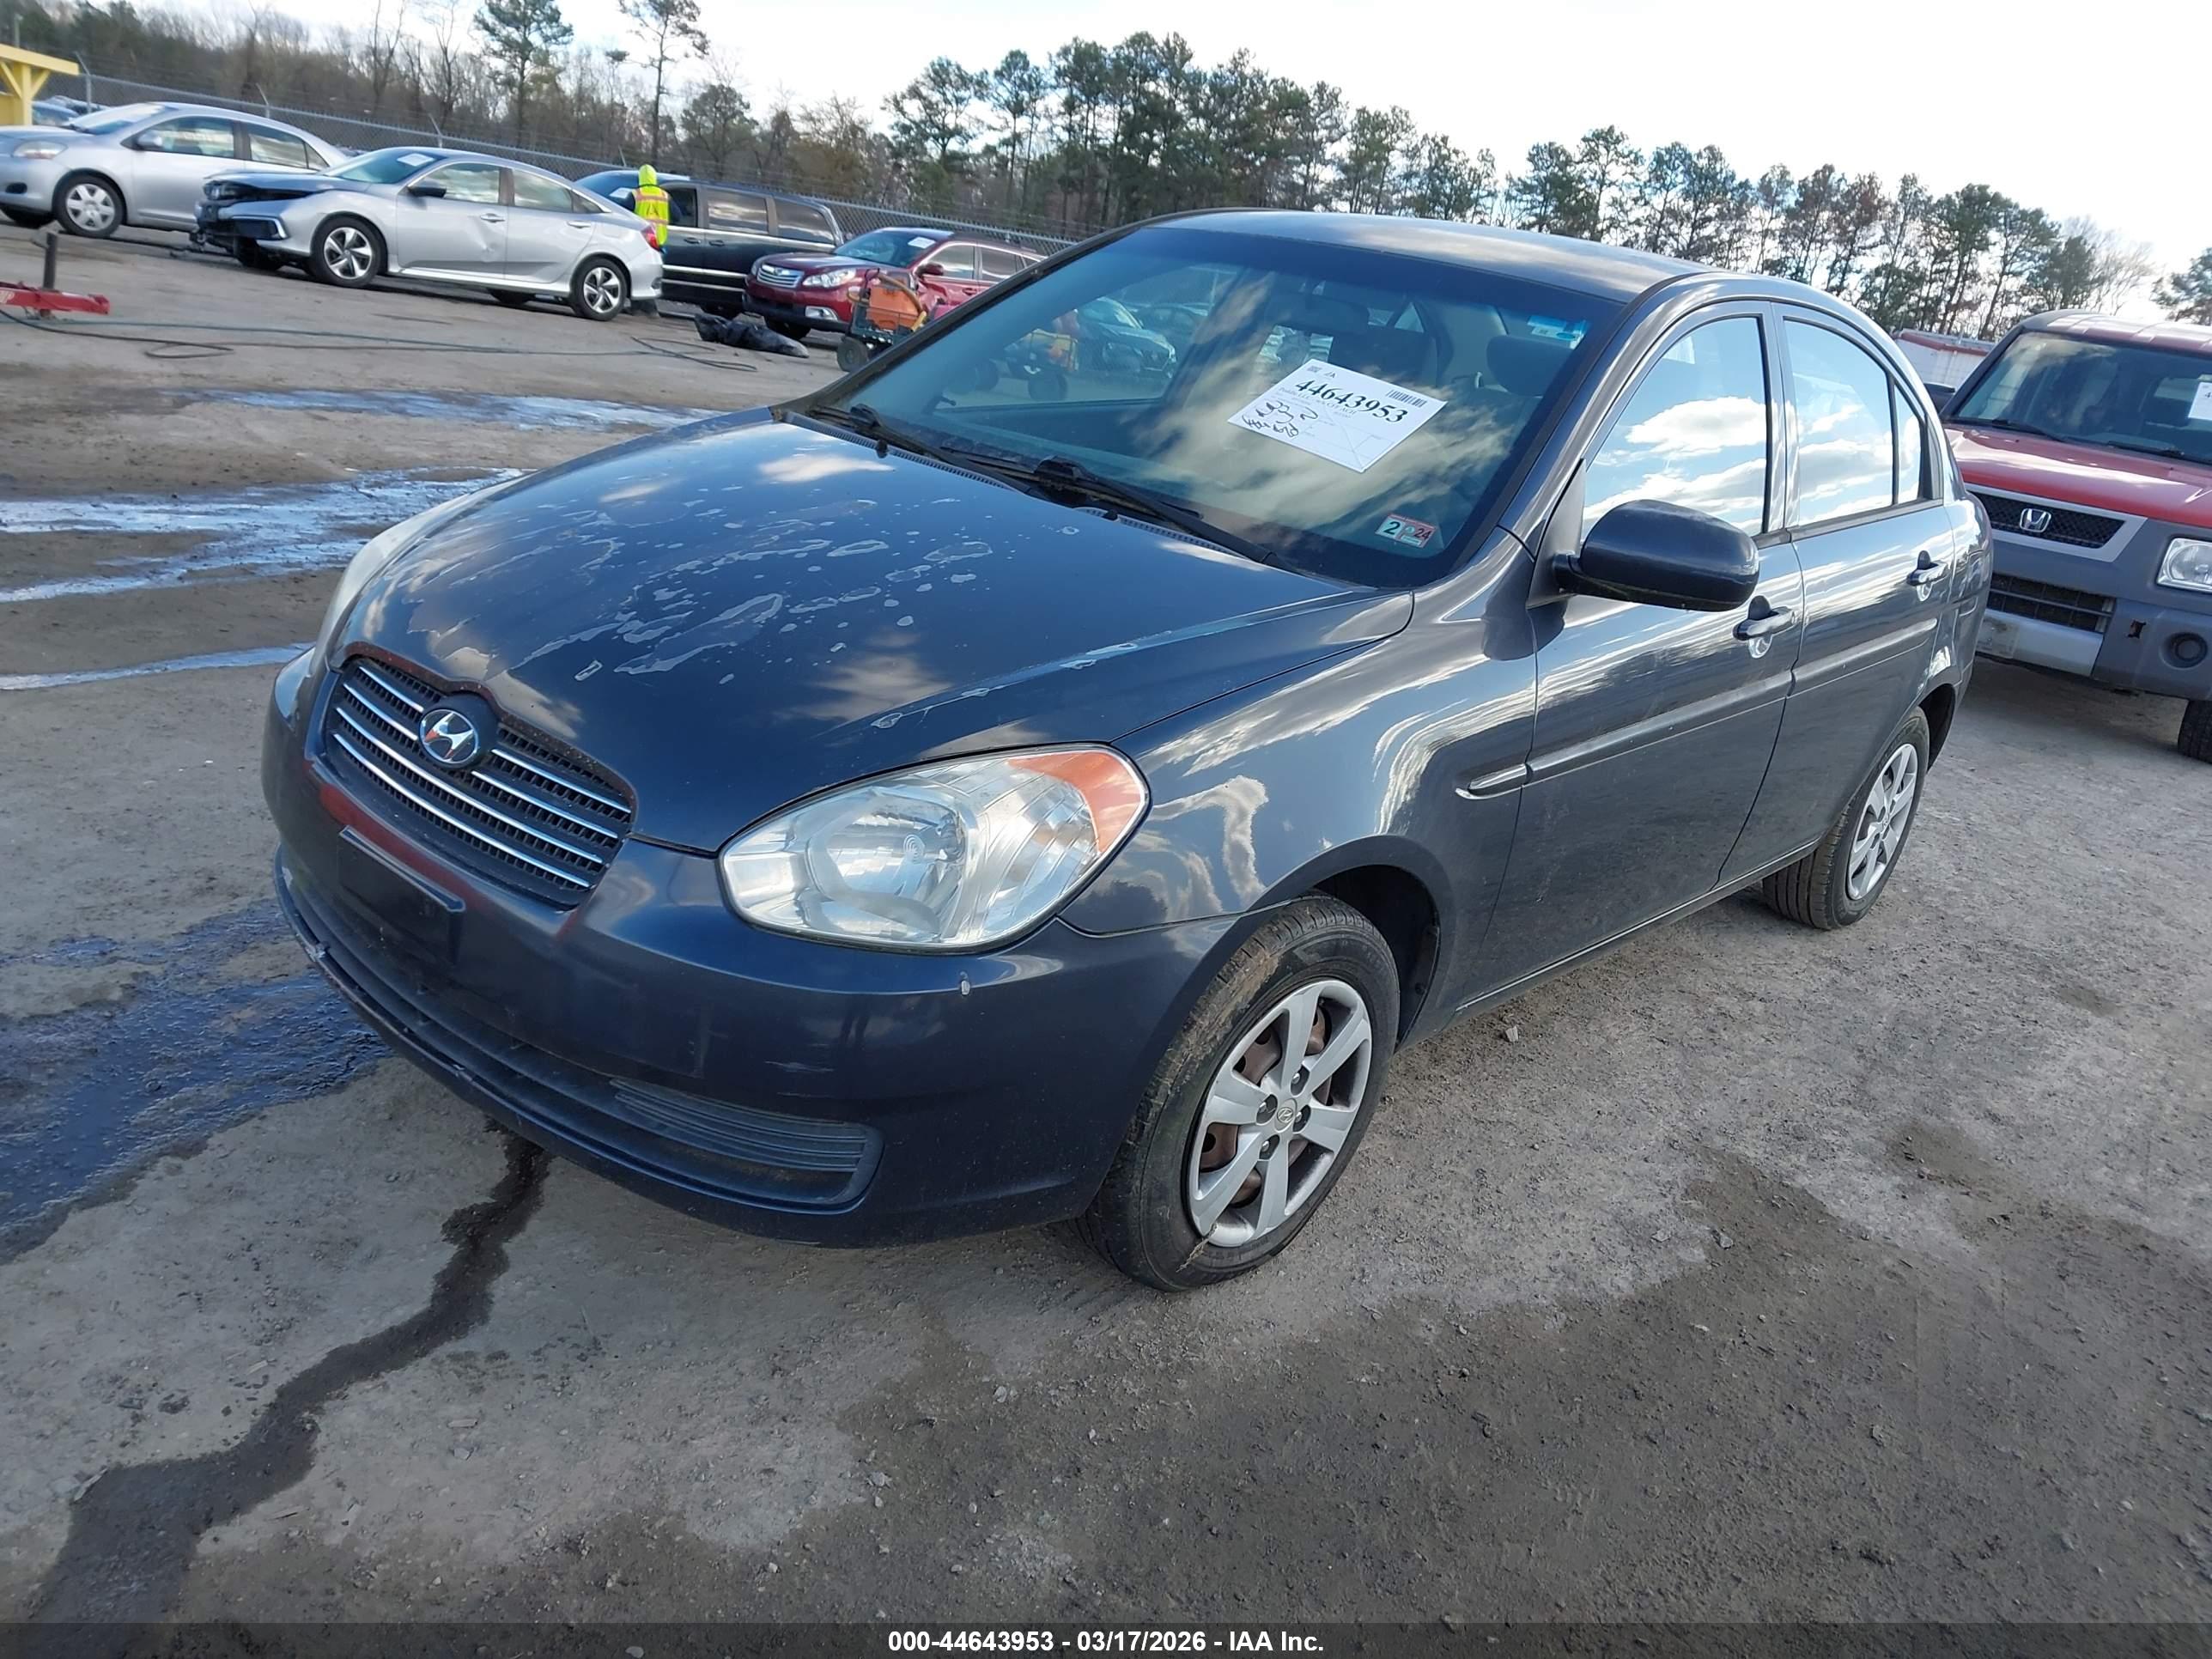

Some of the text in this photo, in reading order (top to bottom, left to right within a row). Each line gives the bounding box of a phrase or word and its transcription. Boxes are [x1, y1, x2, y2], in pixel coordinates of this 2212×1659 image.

[1295, 380, 1408, 422] 44643953
[1383, 520, 1401, 535] 2
[1414, 528, 1431, 540] 24
